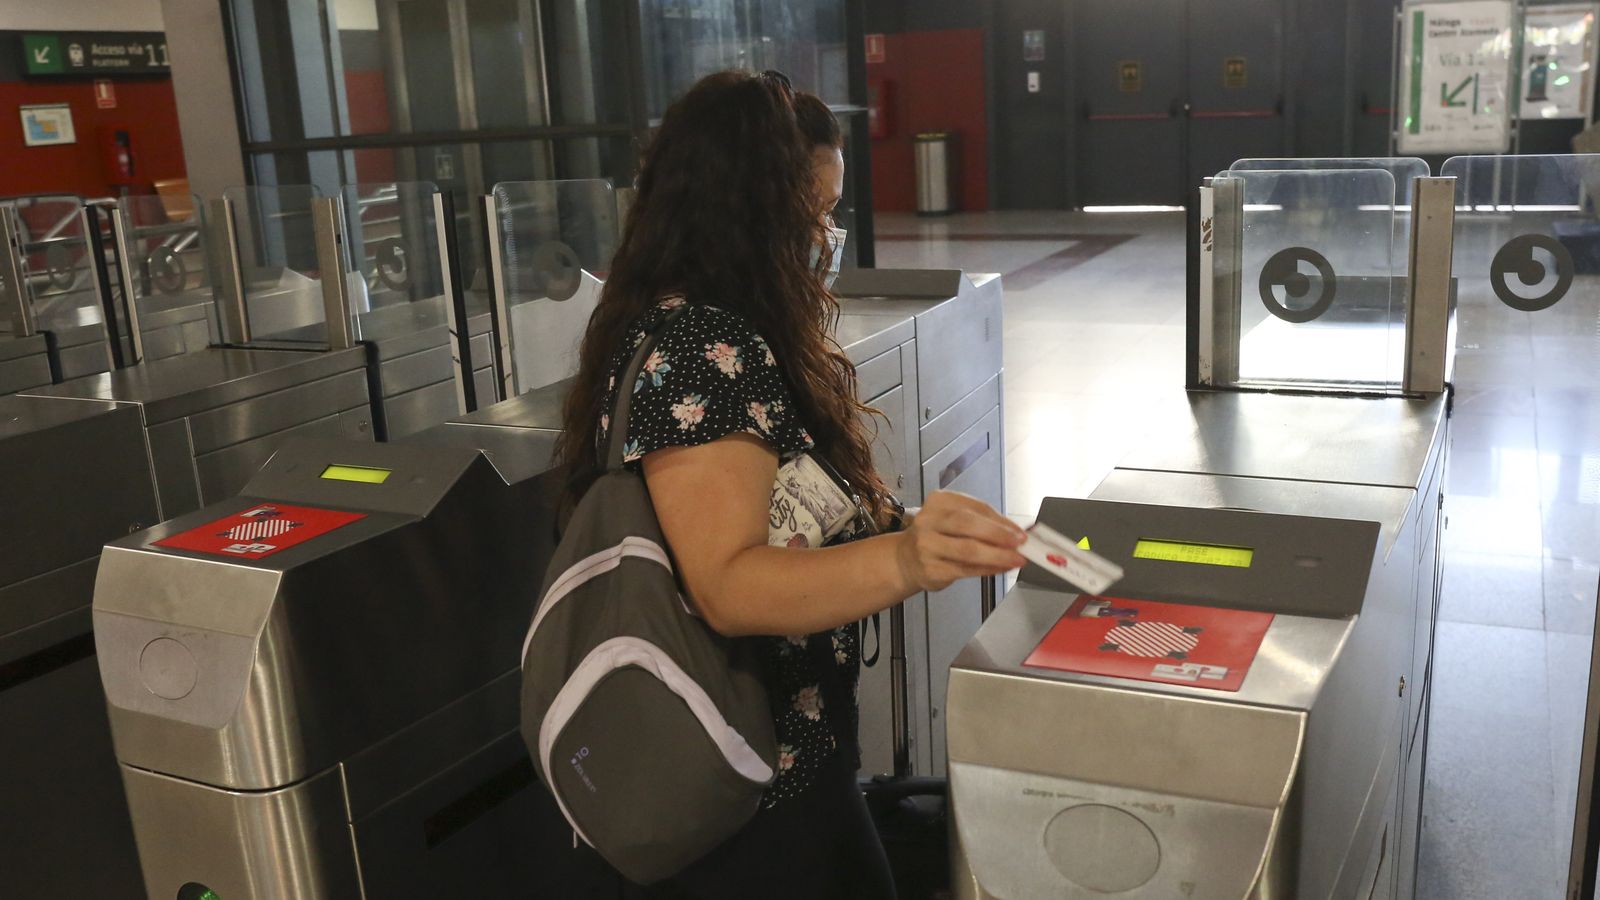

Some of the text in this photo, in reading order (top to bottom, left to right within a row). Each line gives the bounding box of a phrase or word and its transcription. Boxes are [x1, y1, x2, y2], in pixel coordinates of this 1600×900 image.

[92, 44, 126, 55] Acceso
[145, 44, 170, 66] 11
[1180, 546, 1208, 556] PASE
